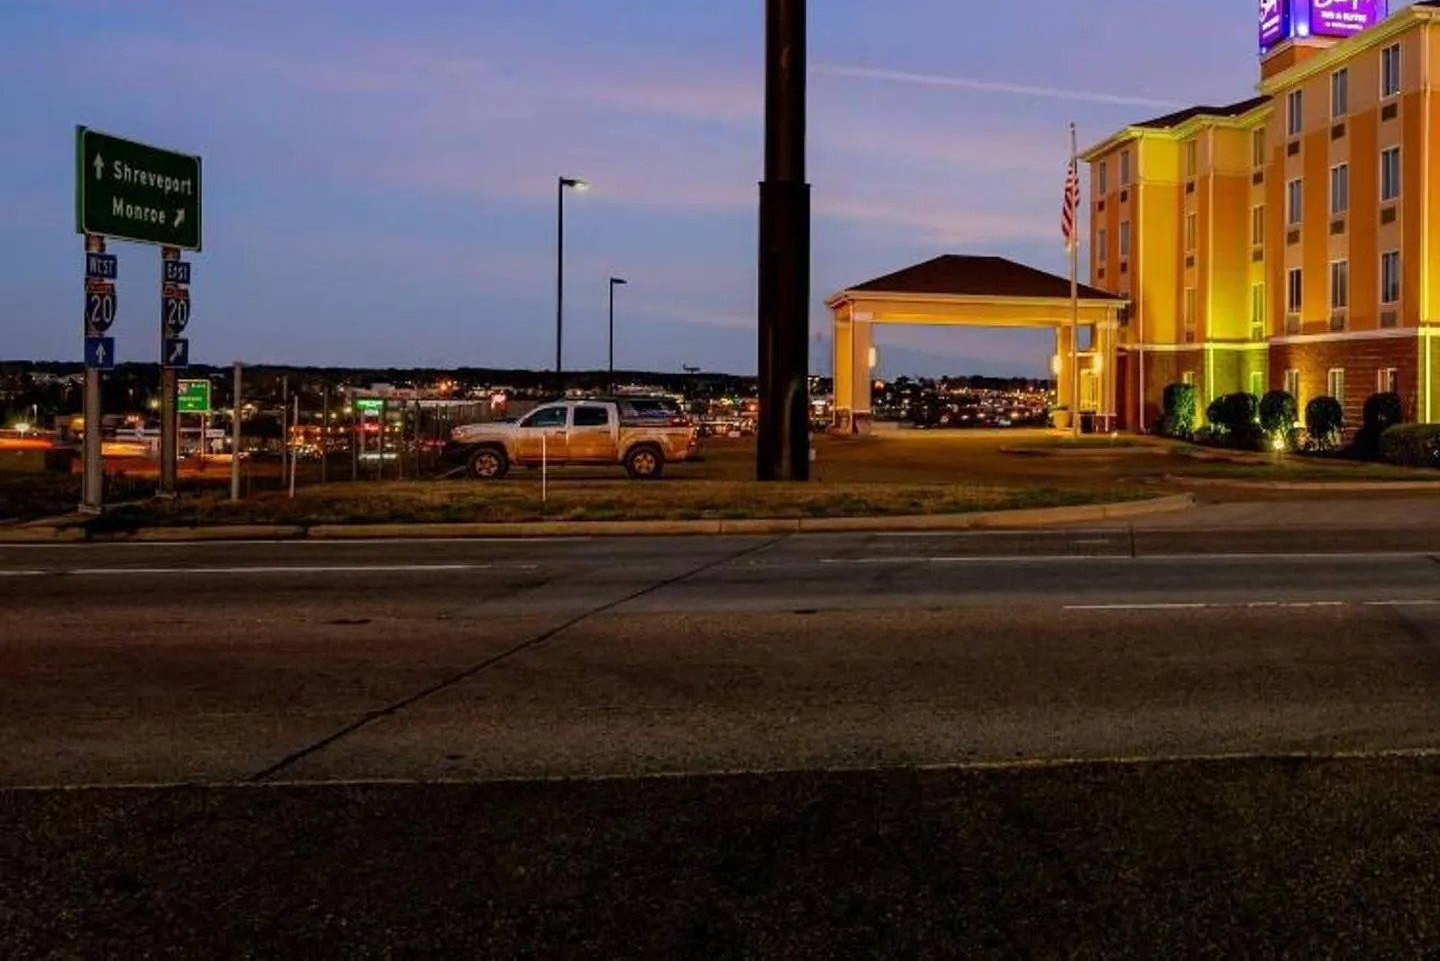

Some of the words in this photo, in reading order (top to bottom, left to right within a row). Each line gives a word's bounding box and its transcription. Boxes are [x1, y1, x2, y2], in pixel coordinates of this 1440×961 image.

[113, 160, 193, 195] Shreveport
[112, 195, 166, 225] Monroe
[89, 256, 115, 275] WEST
[91, 294, 113, 324] 20
[168, 299, 188, 325] 20
